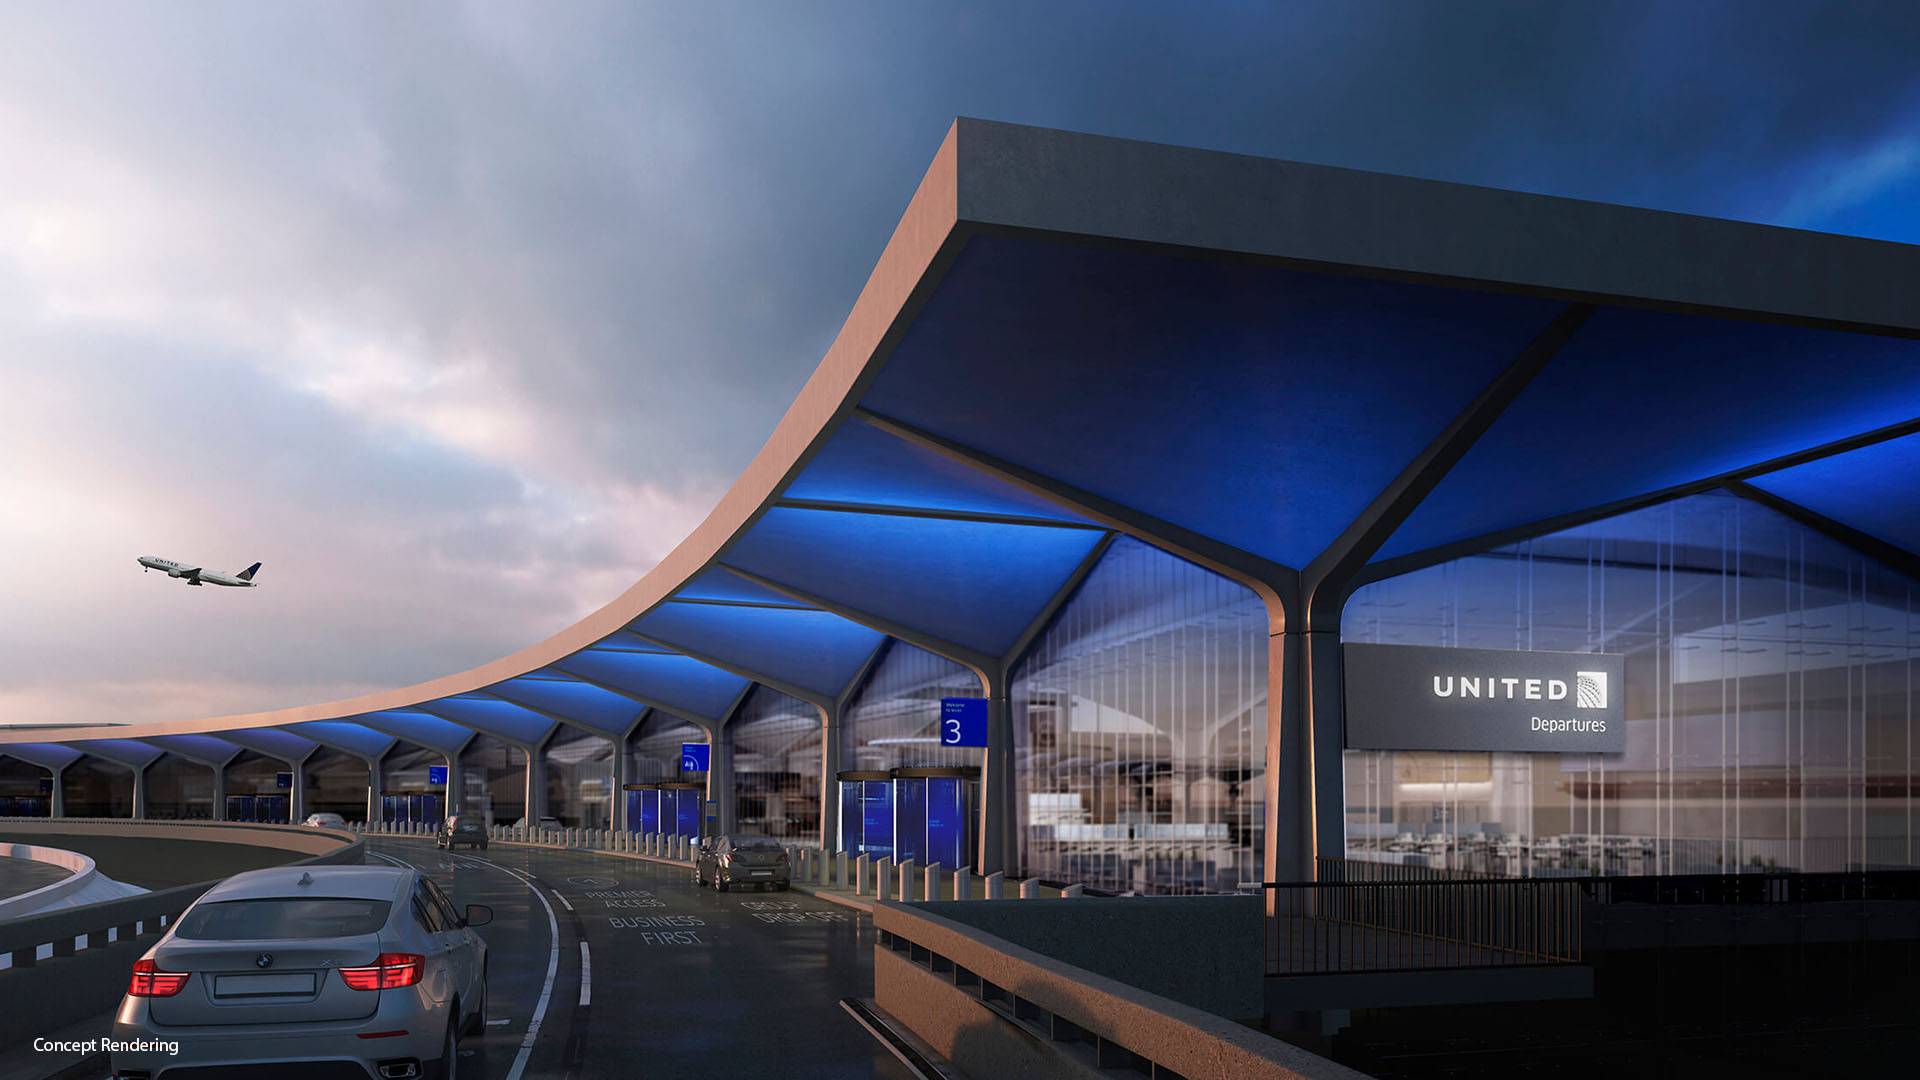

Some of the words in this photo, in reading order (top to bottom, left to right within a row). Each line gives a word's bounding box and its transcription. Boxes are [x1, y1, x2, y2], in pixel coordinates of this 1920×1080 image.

[155, 558, 179, 567] UNITED
[1433, 675, 1568, 701] UNITED
[945, 719, 961, 744] 3
[1531, 716, 1607, 734] Departures
[584, 890, 656, 898] PREMIER
[605, 899, 667, 908] ACCESS
[609, 915, 706, 928] BUSINESS
[641, 931, 704, 945] FIRST
